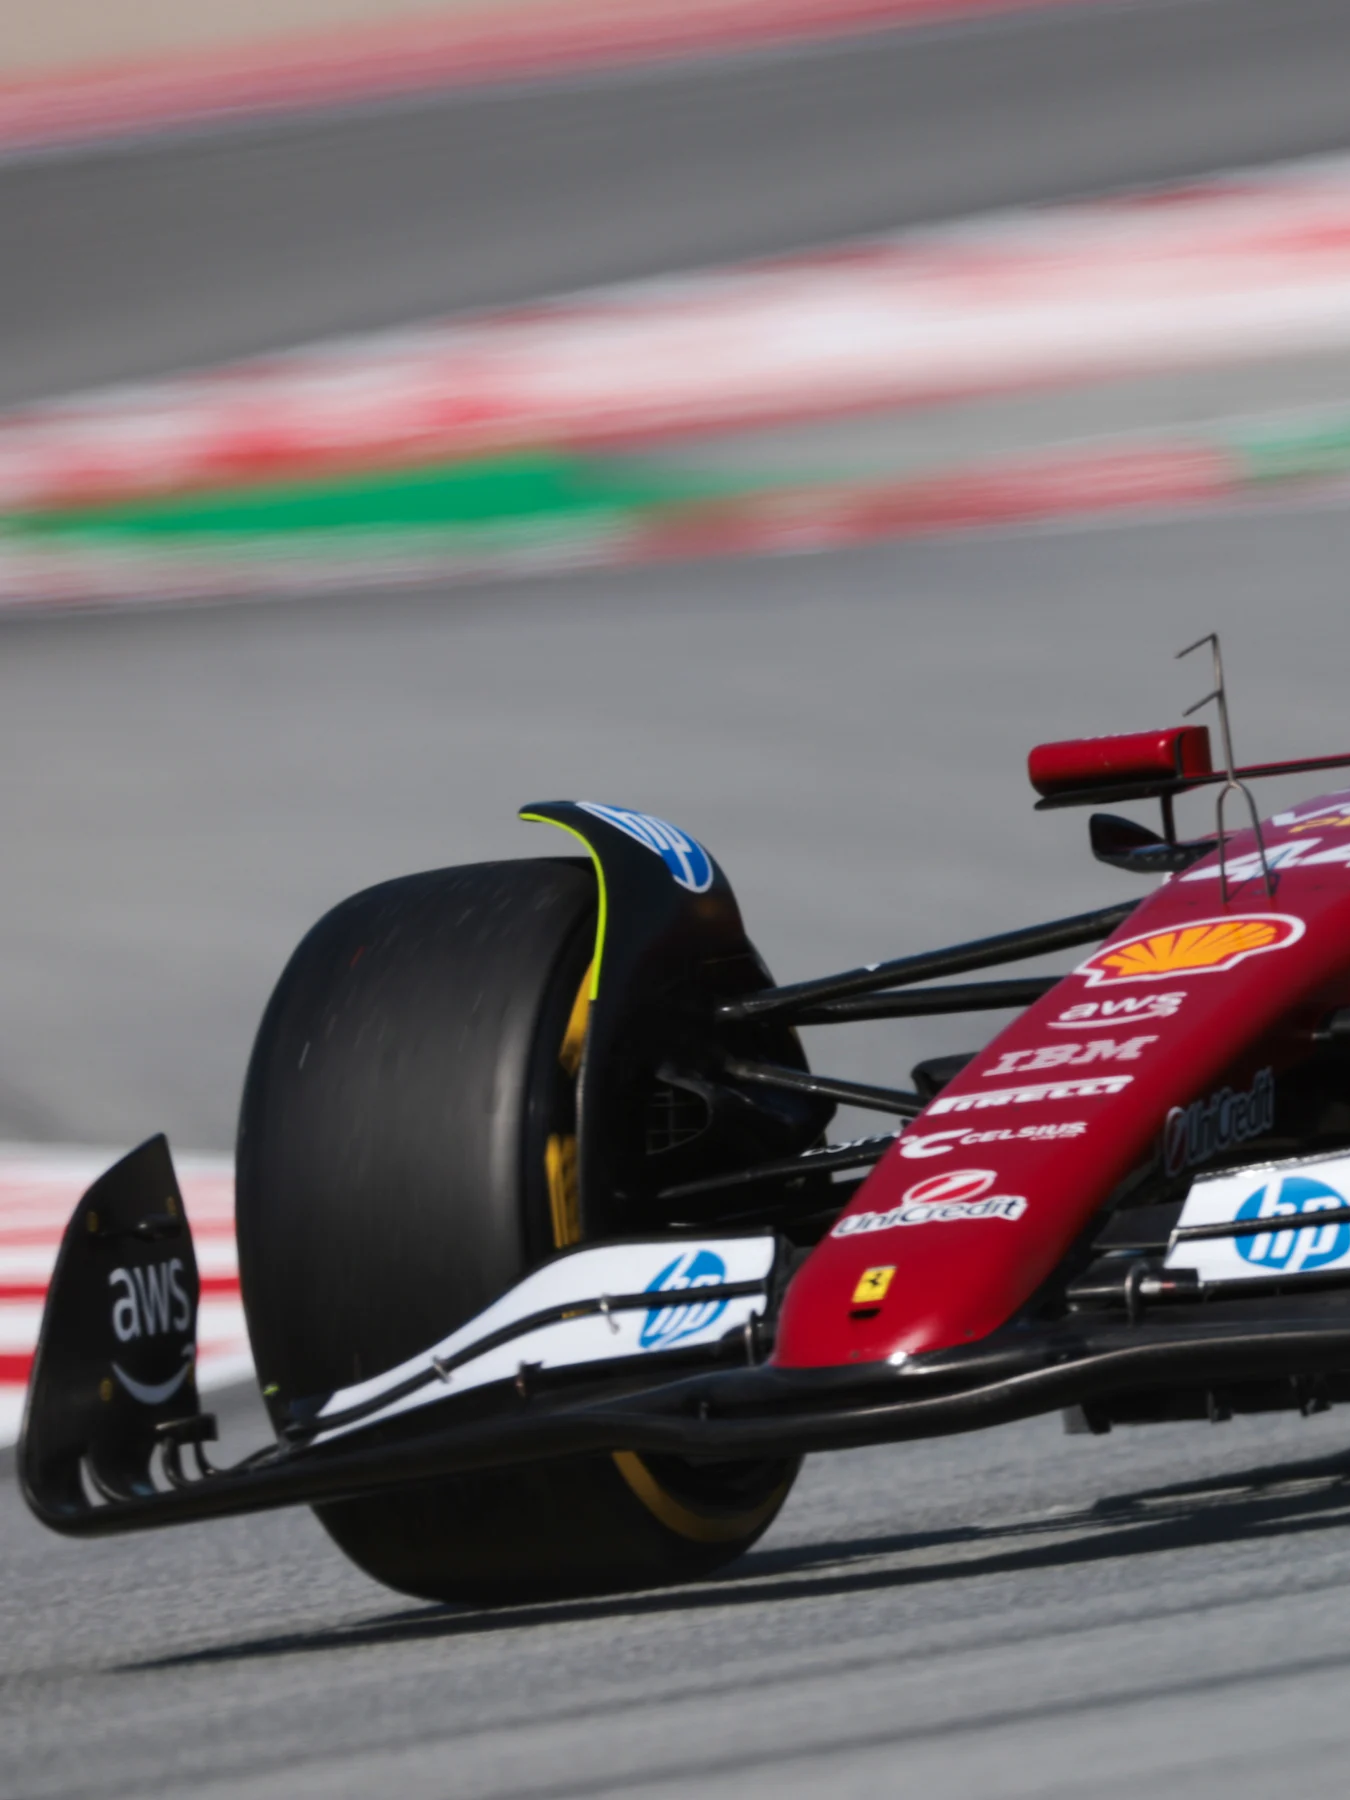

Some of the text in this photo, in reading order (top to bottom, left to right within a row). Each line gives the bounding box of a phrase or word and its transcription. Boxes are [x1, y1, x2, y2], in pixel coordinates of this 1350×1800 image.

[583, 803, 709, 890] hp
[1059, 991, 1188, 1022] aws
[981, 1034, 1160, 1078] IBM
[926, 1075, 1135, 1116] PIRELLI
[959, 1121, 1088, 1145] CELSIUS
[834, 1197, 1023, 1236] UniCredit
[109, 1258, 190, 1342] aws
[640, 1250, 726, 1349] hp
